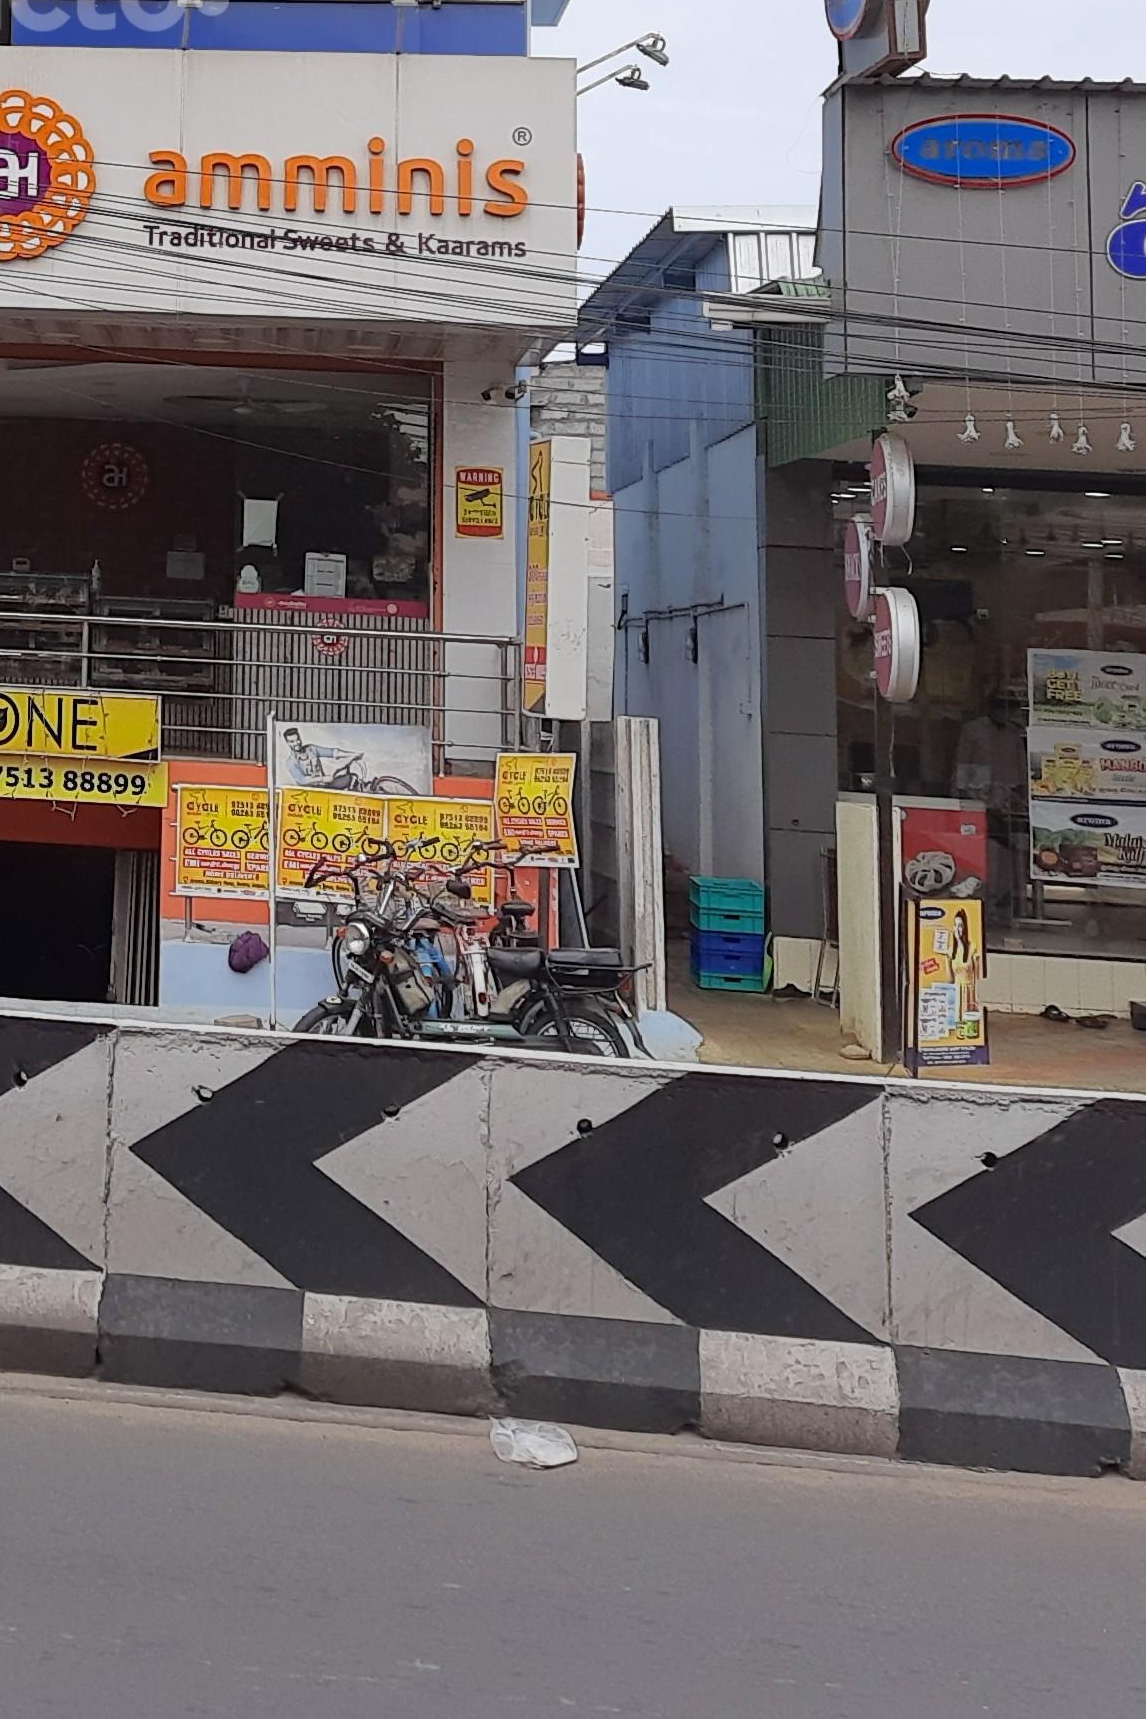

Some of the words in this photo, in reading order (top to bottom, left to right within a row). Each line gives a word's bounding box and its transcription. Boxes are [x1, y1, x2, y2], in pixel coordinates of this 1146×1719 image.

[143, 137, 530, 219] amminis
[144, 225, 277, 252] Traditional
[281, 228, 376, 255] Sweets
[386, 232, 407, 256] &
[417, 232, 528, 259] Kaarams
[459, 472, 500, 483] WARNING
[62, 770, 147, 796] 88899
[187, 802, 219, 813] CYCLE
[287, 803, 321, 815] CYCLE
[394, 814, 428, 825] CYCLE
